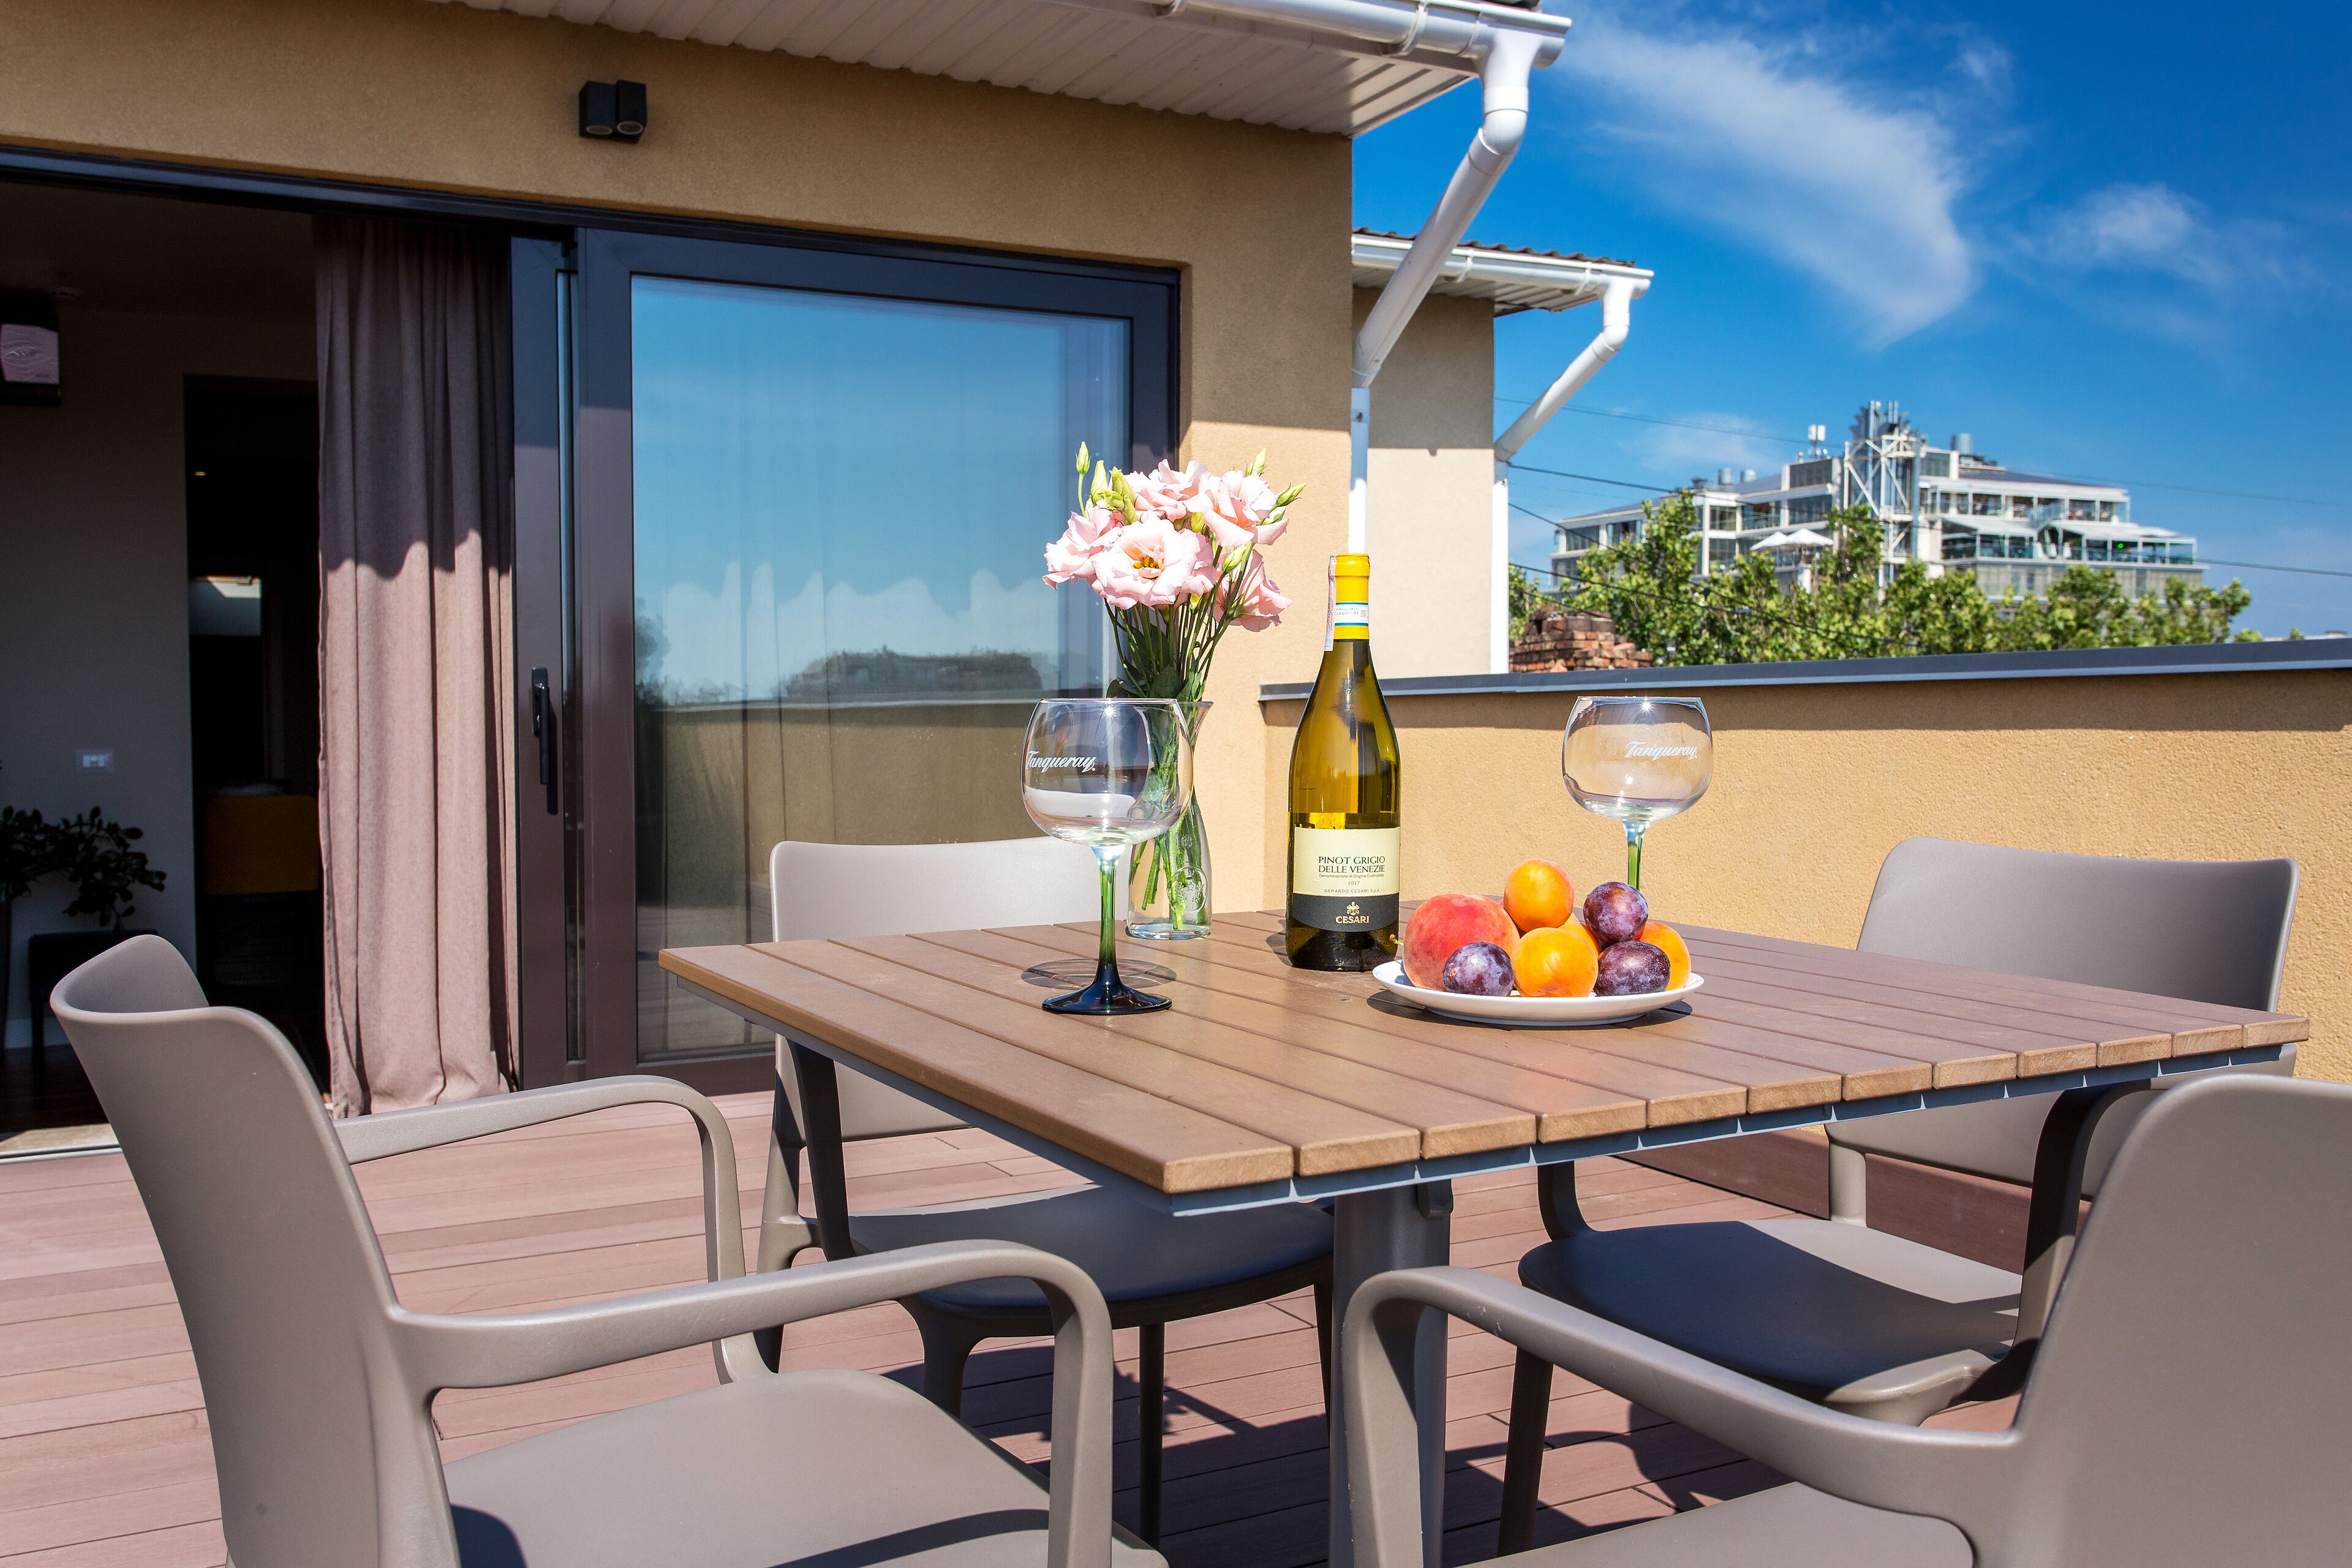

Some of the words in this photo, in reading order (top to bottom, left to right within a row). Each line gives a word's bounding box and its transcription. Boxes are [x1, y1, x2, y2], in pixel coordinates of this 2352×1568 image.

[1624, 741, 1697, 761] Tanqueray
[1026, 750, 1096, 773] Tanqueray
[1353, 856, 1385, 864] GRIGIO
[1319, 865, 1348, 873] DELLE
[1350, 865, 1385, 873] VENEZIE
